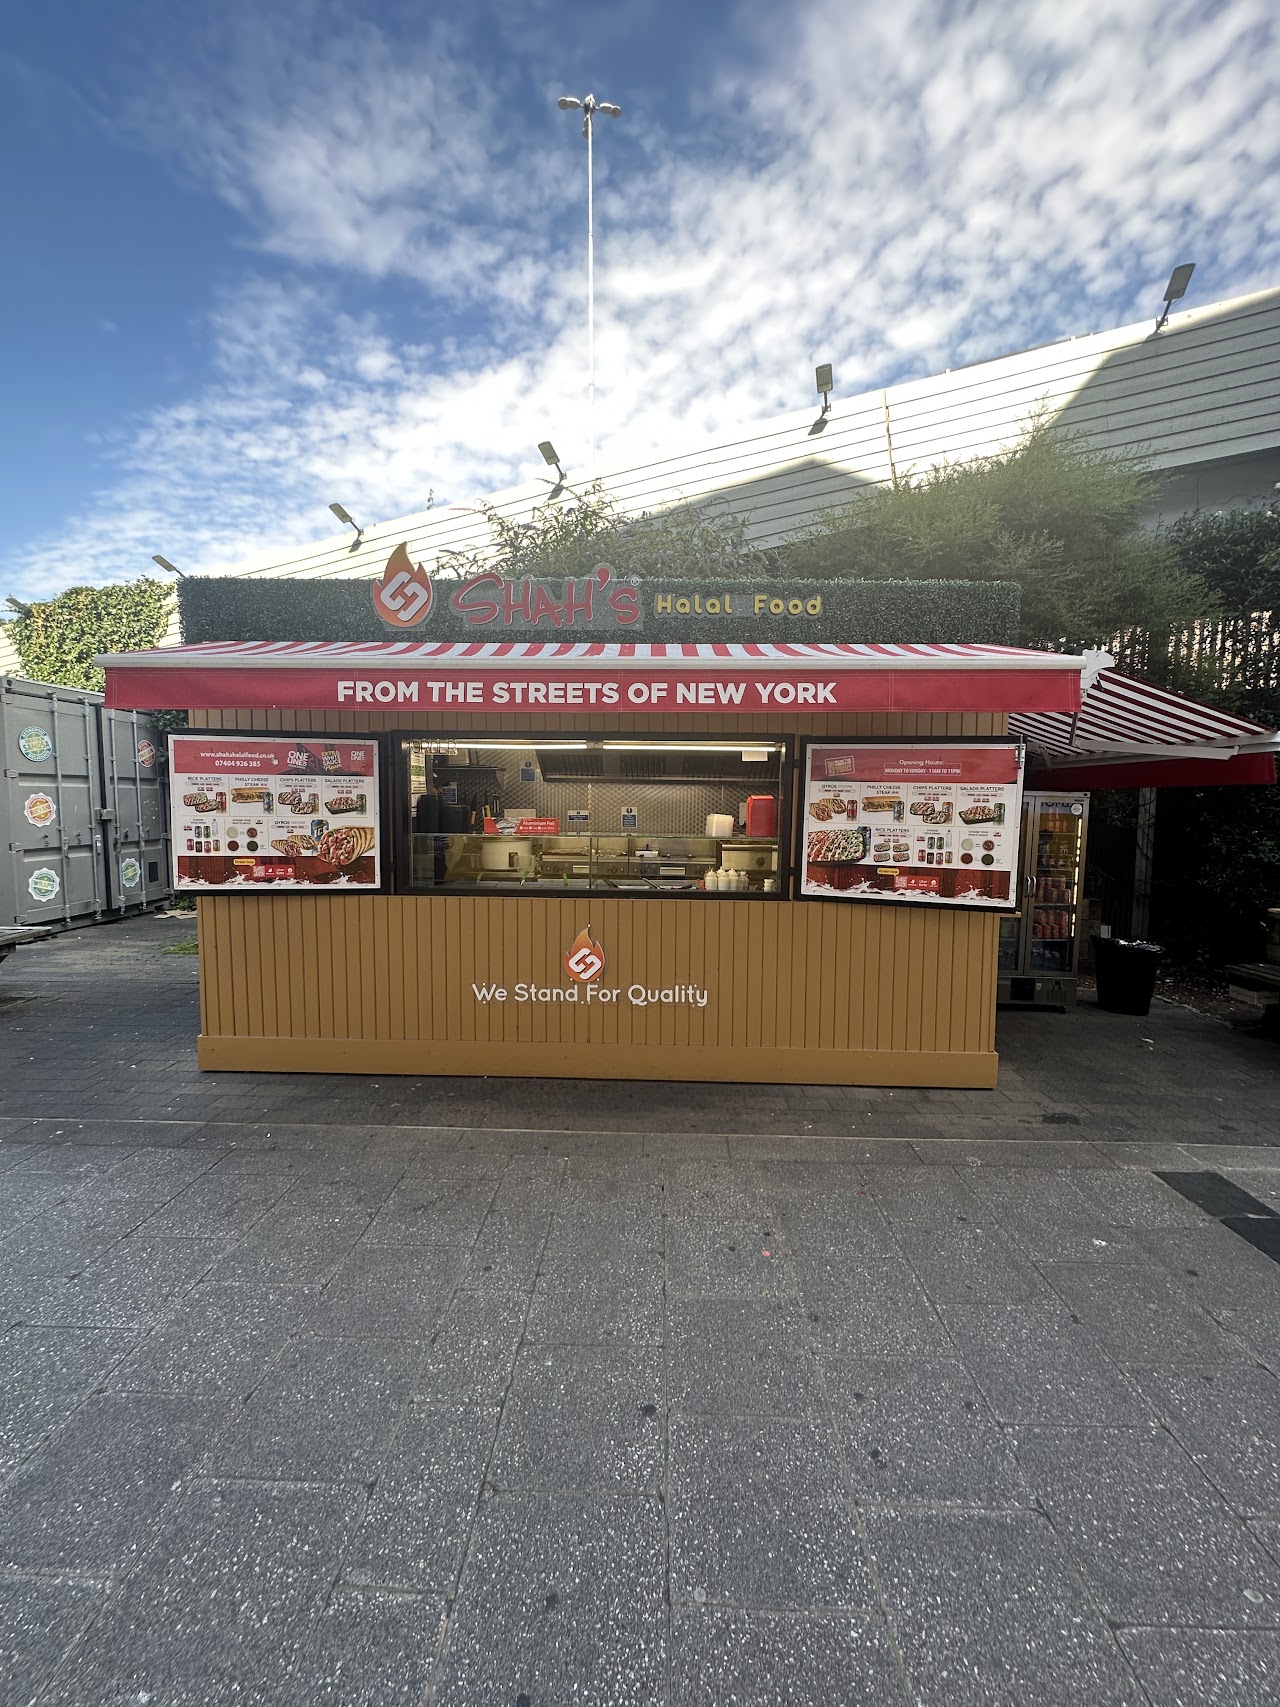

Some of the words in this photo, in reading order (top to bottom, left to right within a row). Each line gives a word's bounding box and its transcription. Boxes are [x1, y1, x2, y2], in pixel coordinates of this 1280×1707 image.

[656, 594, 733, 615] Halal
[753, 595, 822, 616] Food
[337, 681, 419, 703] FROM
[427, 681, 484, 703] THE
[492, 682, 619, 704] STREETS
[627, 682, 668, 704] OF
[676, 682, 747, 704] NEW
[754, 682, 838, 704] YORK
[23, 741, 50, 752] SAMOSA
[412, 740, 458, 756] ORDER
[288, 750, 309, 761] ONE
[899, 759, 924, 767] Opening
[33, 880, 55, 889] WRAPS
[471, 983, 508, 1002] We
[514, 983, 578, 1002] Stand
[586, 984, 621, 1003] For
[627, 984, 708, 1007] Quality
